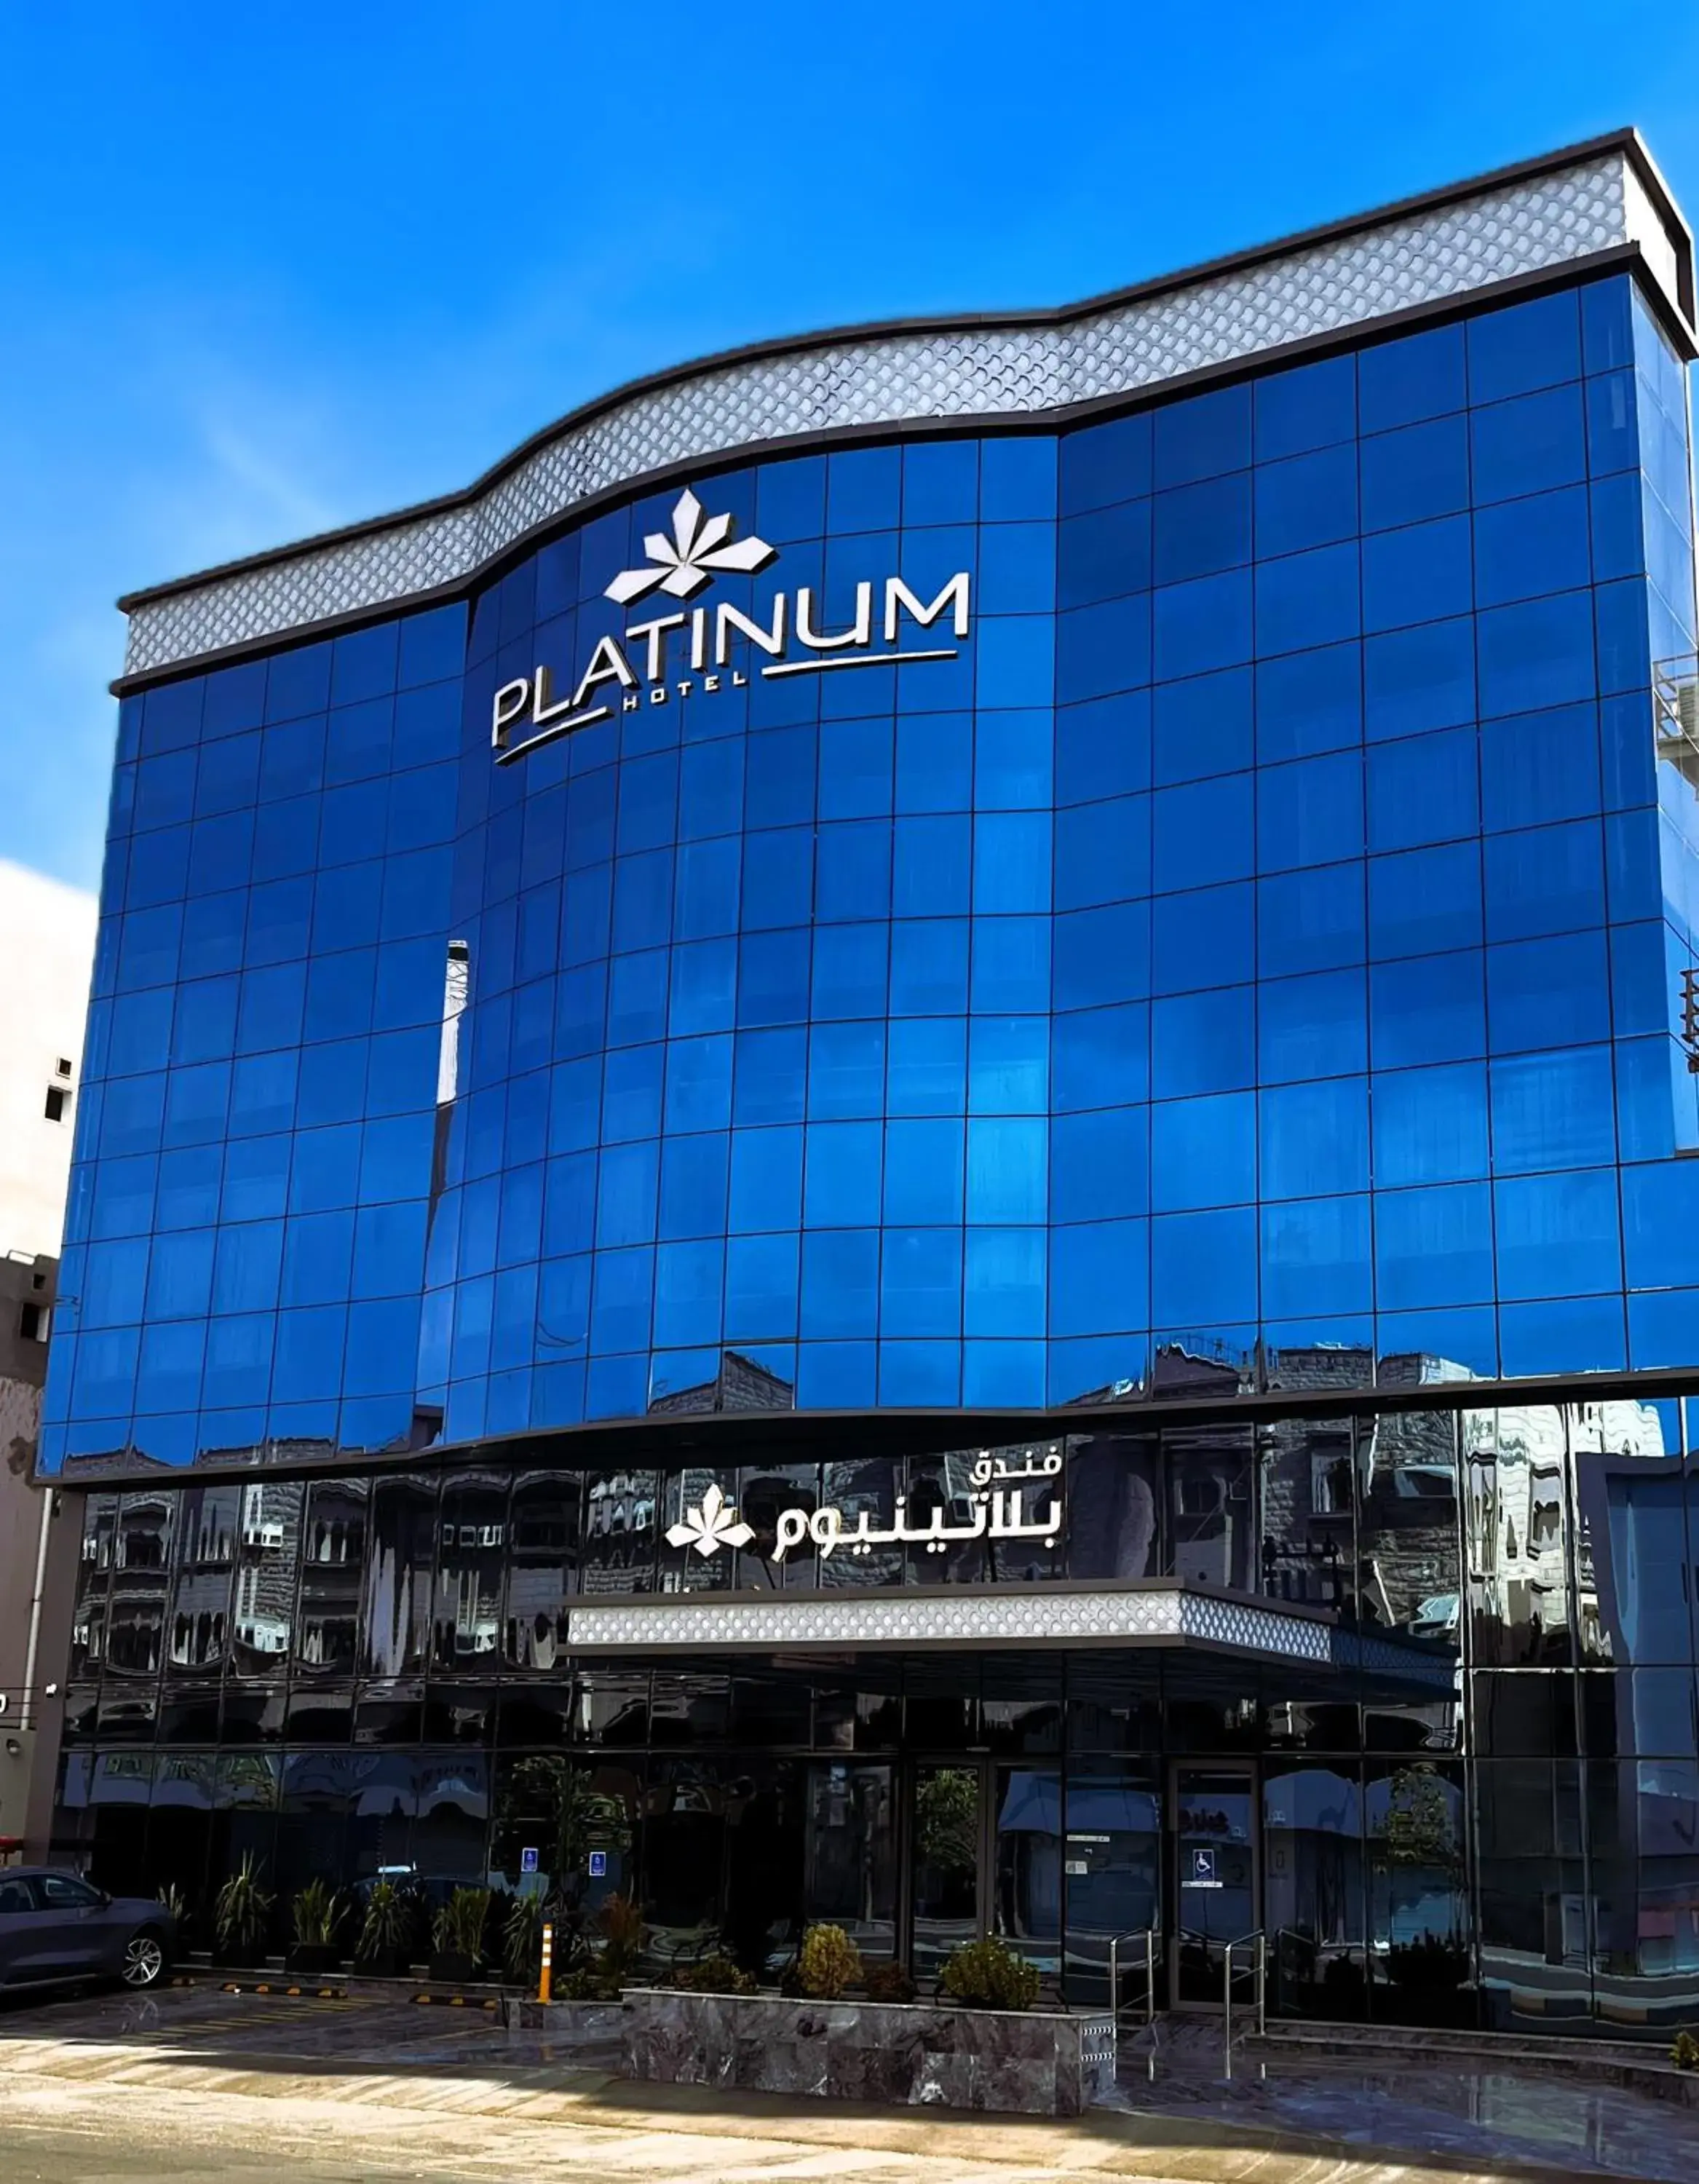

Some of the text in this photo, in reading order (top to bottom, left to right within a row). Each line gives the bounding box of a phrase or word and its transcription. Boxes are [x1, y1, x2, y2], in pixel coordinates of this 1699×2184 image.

[491, 571, 971, 748] PLATINUM
[622, 670, 747, 711] HOTEL
[968, 1445, 1062, 1486] فندق
[771, 1489, 1062, 1563] بلاتينيوم
